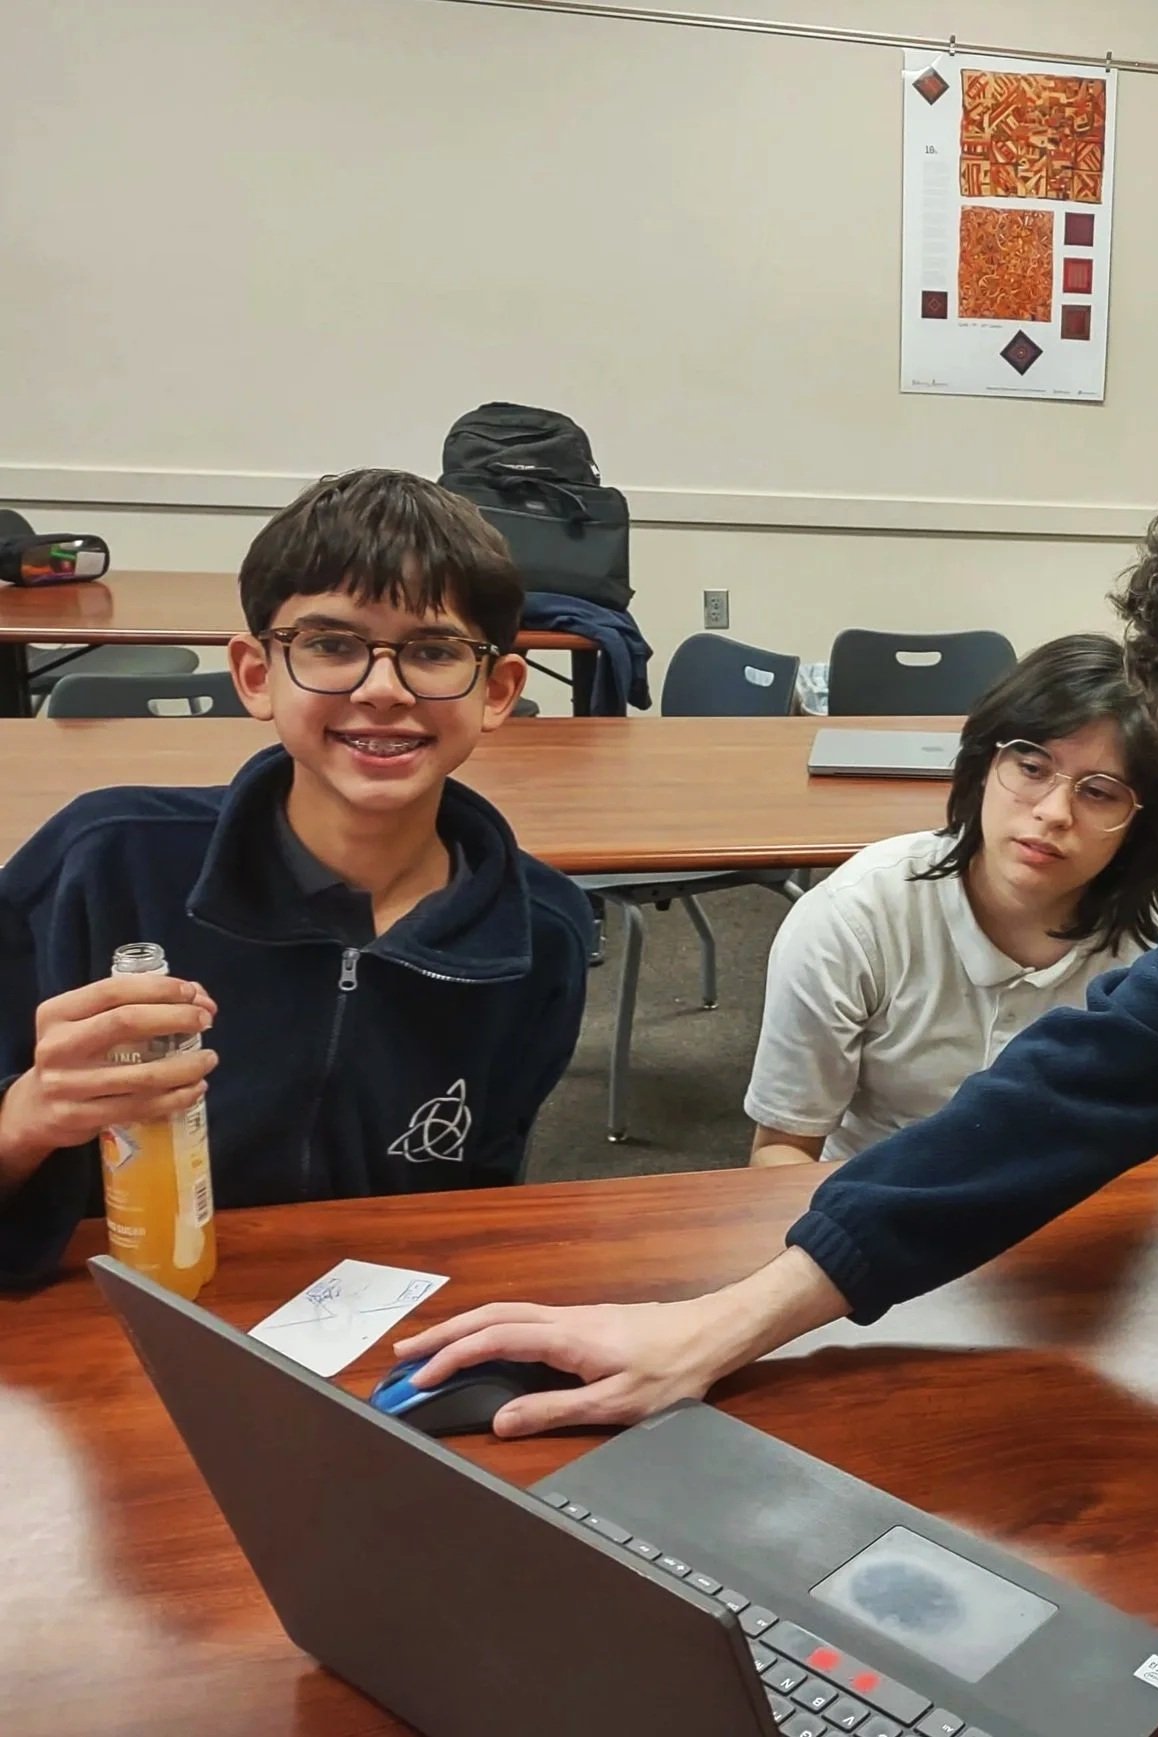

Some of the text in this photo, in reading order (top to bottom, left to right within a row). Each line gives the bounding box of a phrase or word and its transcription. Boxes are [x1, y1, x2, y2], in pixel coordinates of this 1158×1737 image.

[780, 1678, 795, 1690] N
[812, 1697, 825, 1707] B
[842, 1716, 855, 1726] V
